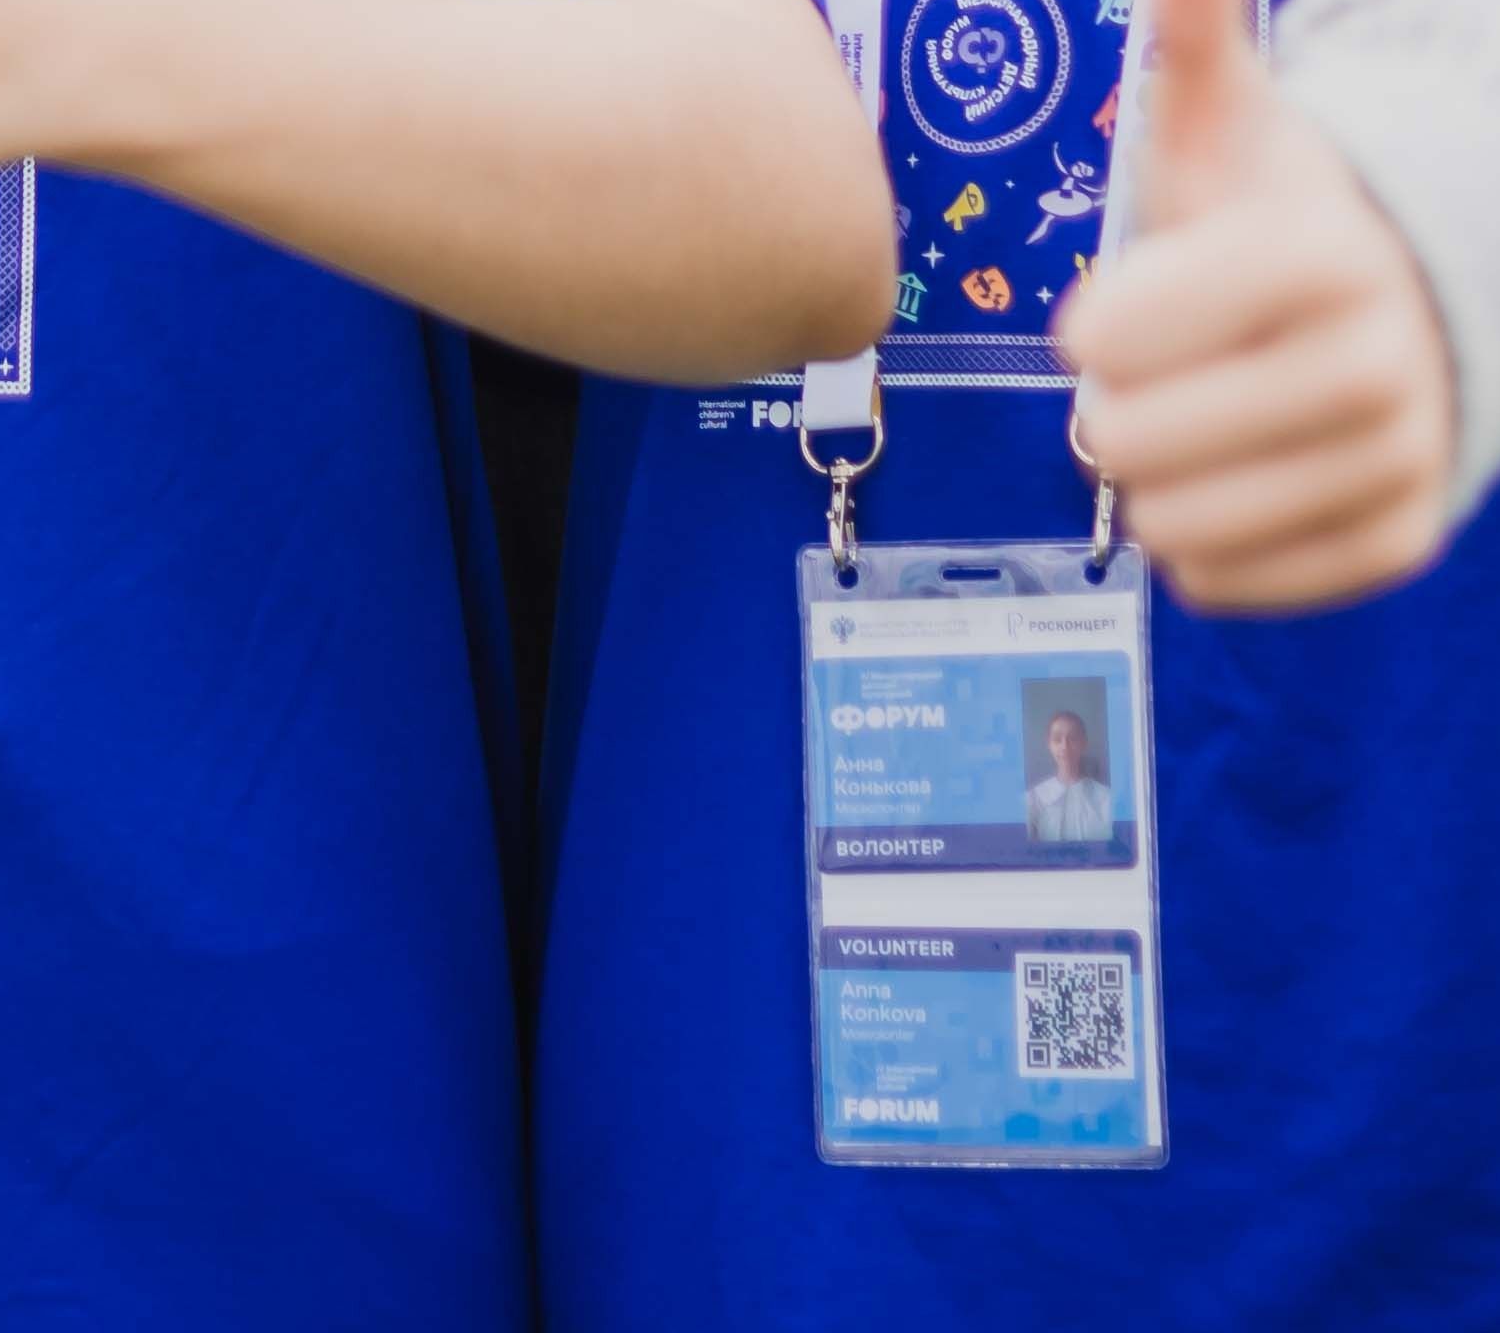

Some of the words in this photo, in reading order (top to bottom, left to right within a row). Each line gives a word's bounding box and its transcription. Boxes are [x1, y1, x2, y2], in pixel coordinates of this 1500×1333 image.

[942, 15, 971, 60] ФОРУМ
[926, 38, 985, 100] КУЛЬТУРНЫЙ
[965, 60, 1018, 122] ДЕТСКИЙ
[698, 400, 745, 408] International
[1029, 618, 1117, 632] РОСКОНЦЕРТ
[831, 704, 945, 736] ФОРУМ
[834, 756, 884, 773] Анна
[834, 779, 931, 796] Конькова
[837, 839, 944, 857] ВОЛОНТЕР
[839, 939, 954, 956] VOLUNTEER
[841, 981, 891, 999] Anna
[841, 1004, 926, 1023] Konkova
[844, 1098, 939, 1123] FORUM
